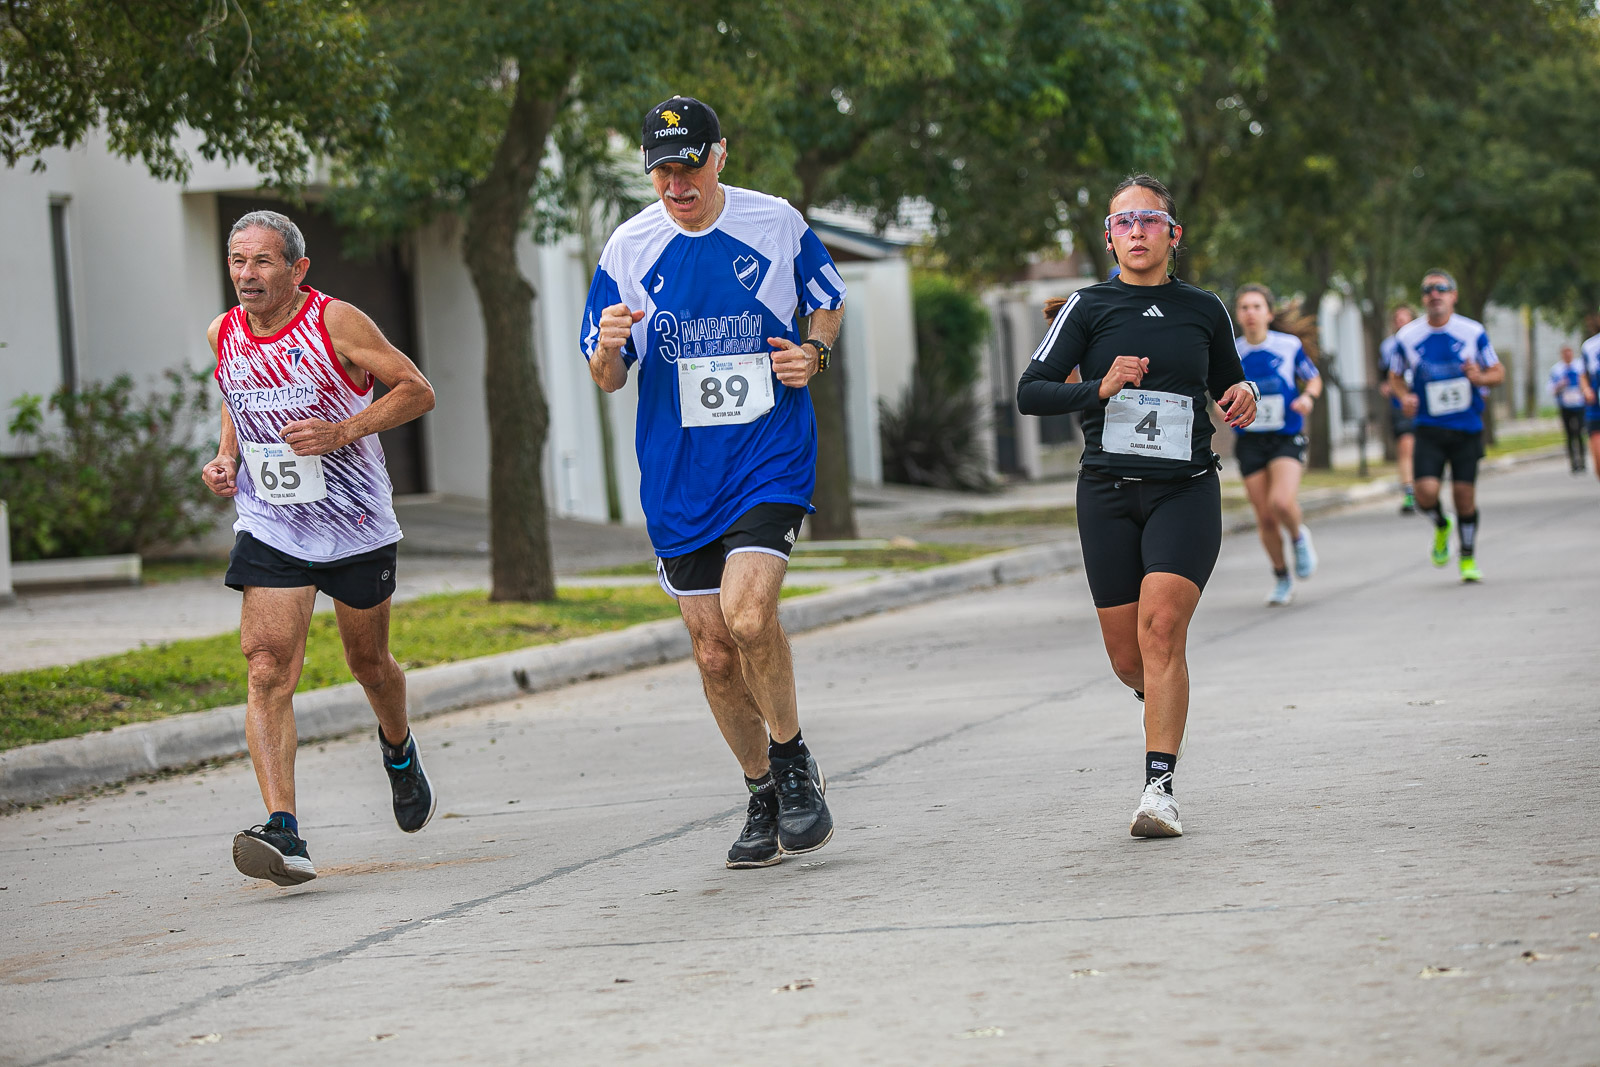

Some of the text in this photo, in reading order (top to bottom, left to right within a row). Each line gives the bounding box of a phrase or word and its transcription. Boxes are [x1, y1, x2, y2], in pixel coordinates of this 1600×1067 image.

[654, 127, 689, 139] TORINO
[654, 311, 681, 364] 3
[681, 310, 762, 343] MARATÓN
[246, 385, 314, 405] TRIATLON
[700, 374, 750, 410] 89
[1135, 411, 1161, 441] 4
[260, 460, 301, 491] 65
